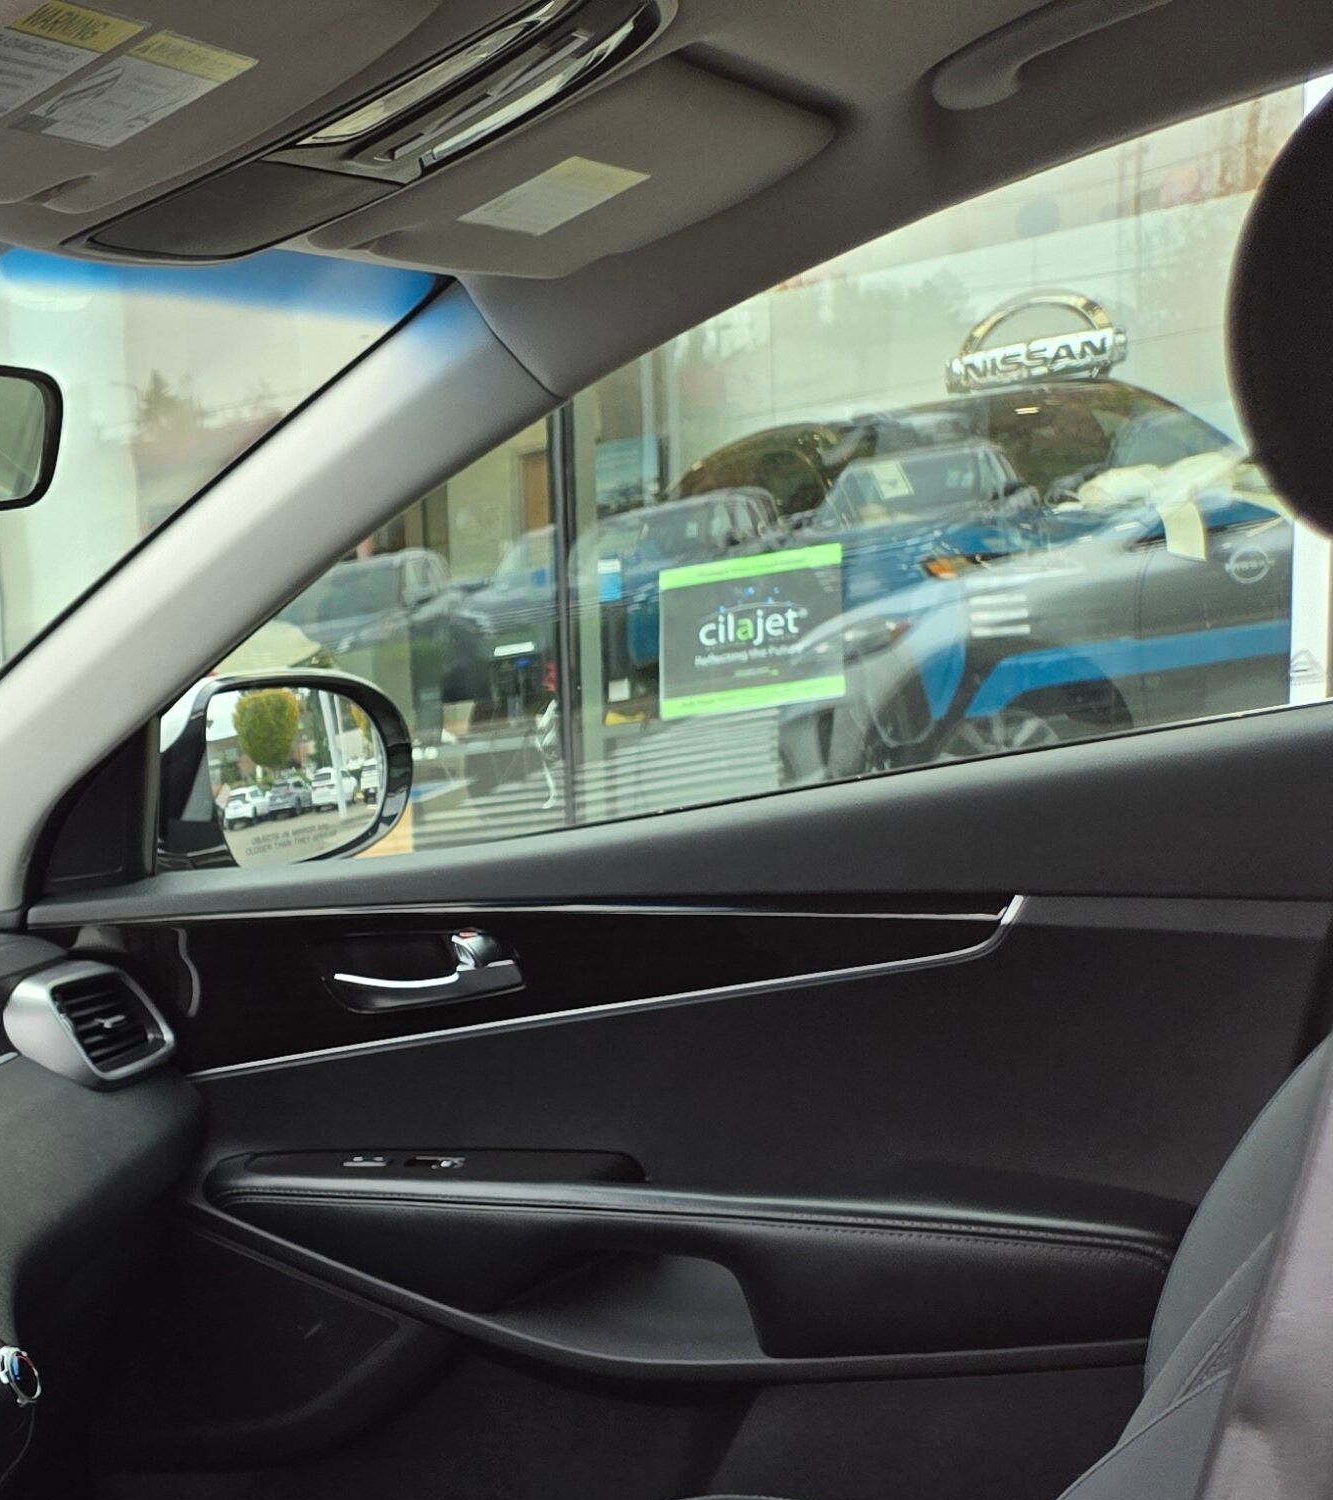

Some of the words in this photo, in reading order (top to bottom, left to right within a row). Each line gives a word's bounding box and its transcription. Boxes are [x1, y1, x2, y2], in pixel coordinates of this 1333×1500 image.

[23, 7, 110, 41] WARNING
[962, 335, 1108, 383] NISSAN
[698, 608, 800, 646] cilajet
